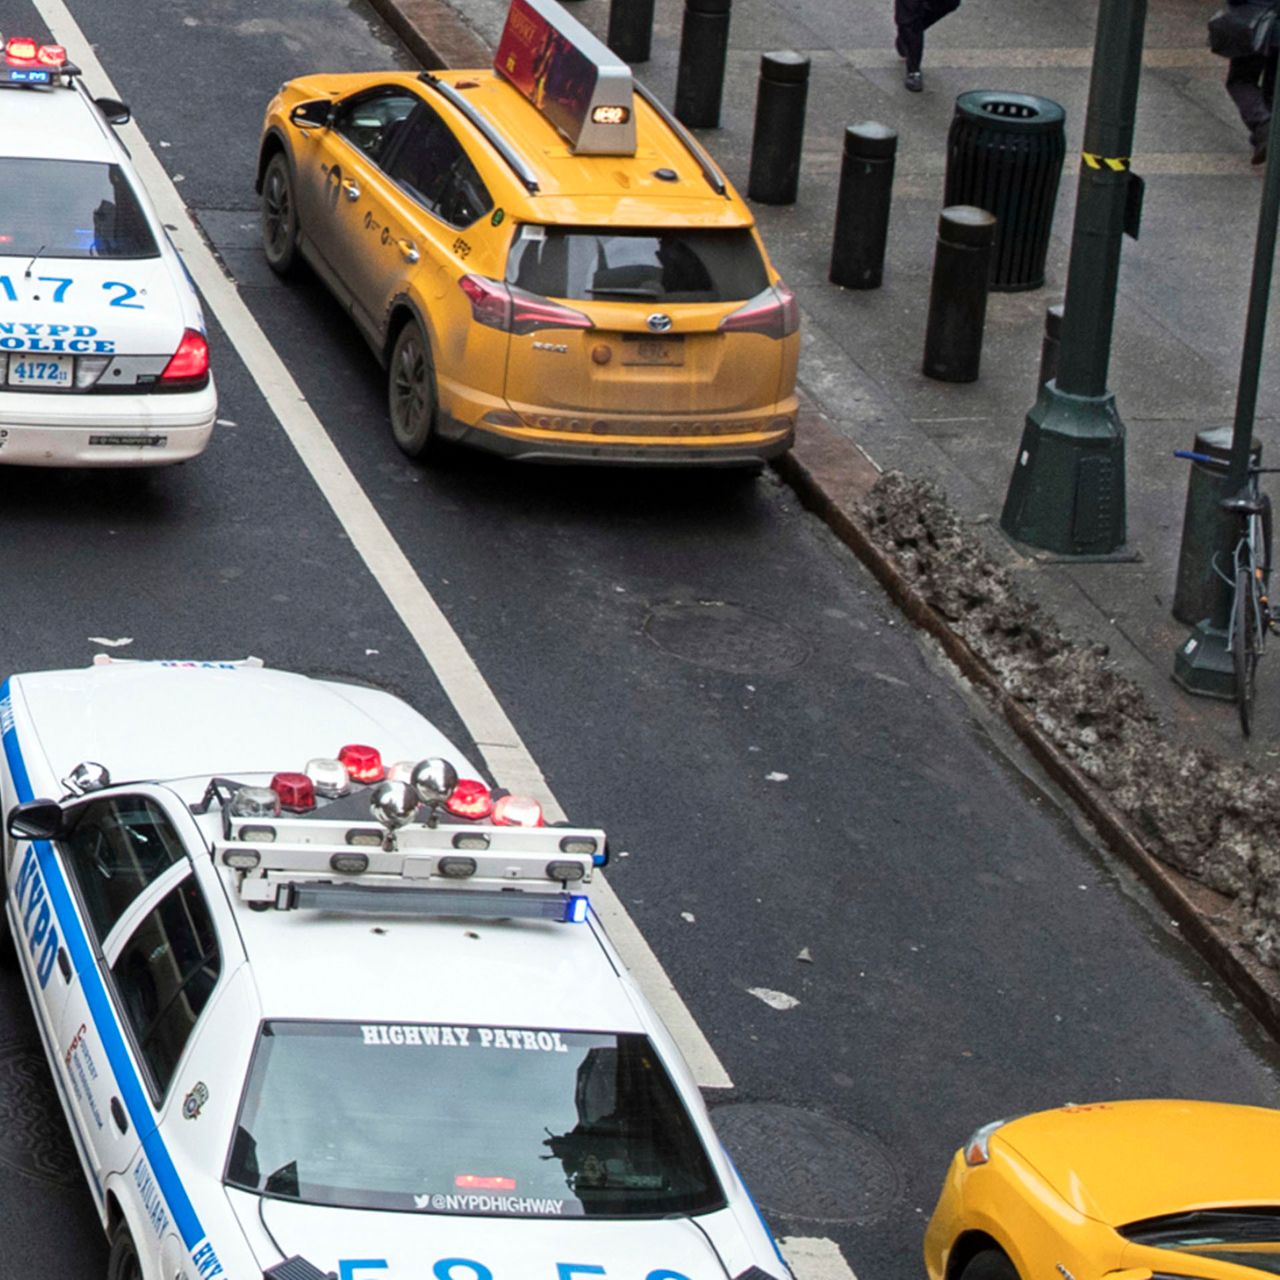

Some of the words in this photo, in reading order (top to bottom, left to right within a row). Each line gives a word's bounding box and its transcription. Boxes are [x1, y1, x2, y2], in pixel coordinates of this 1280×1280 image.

[14, 361, 60, 381] 4172
[11, 845, 60, 991] NYPD
[362, 1025, 470, 1048] HIGHWAY
[479, 1029, 567, 1052] PATROL
[133, 1158, 169, 1240] AUXILIARY
[432, 1192, 564, 1217] @NYPDHIGHWAY
